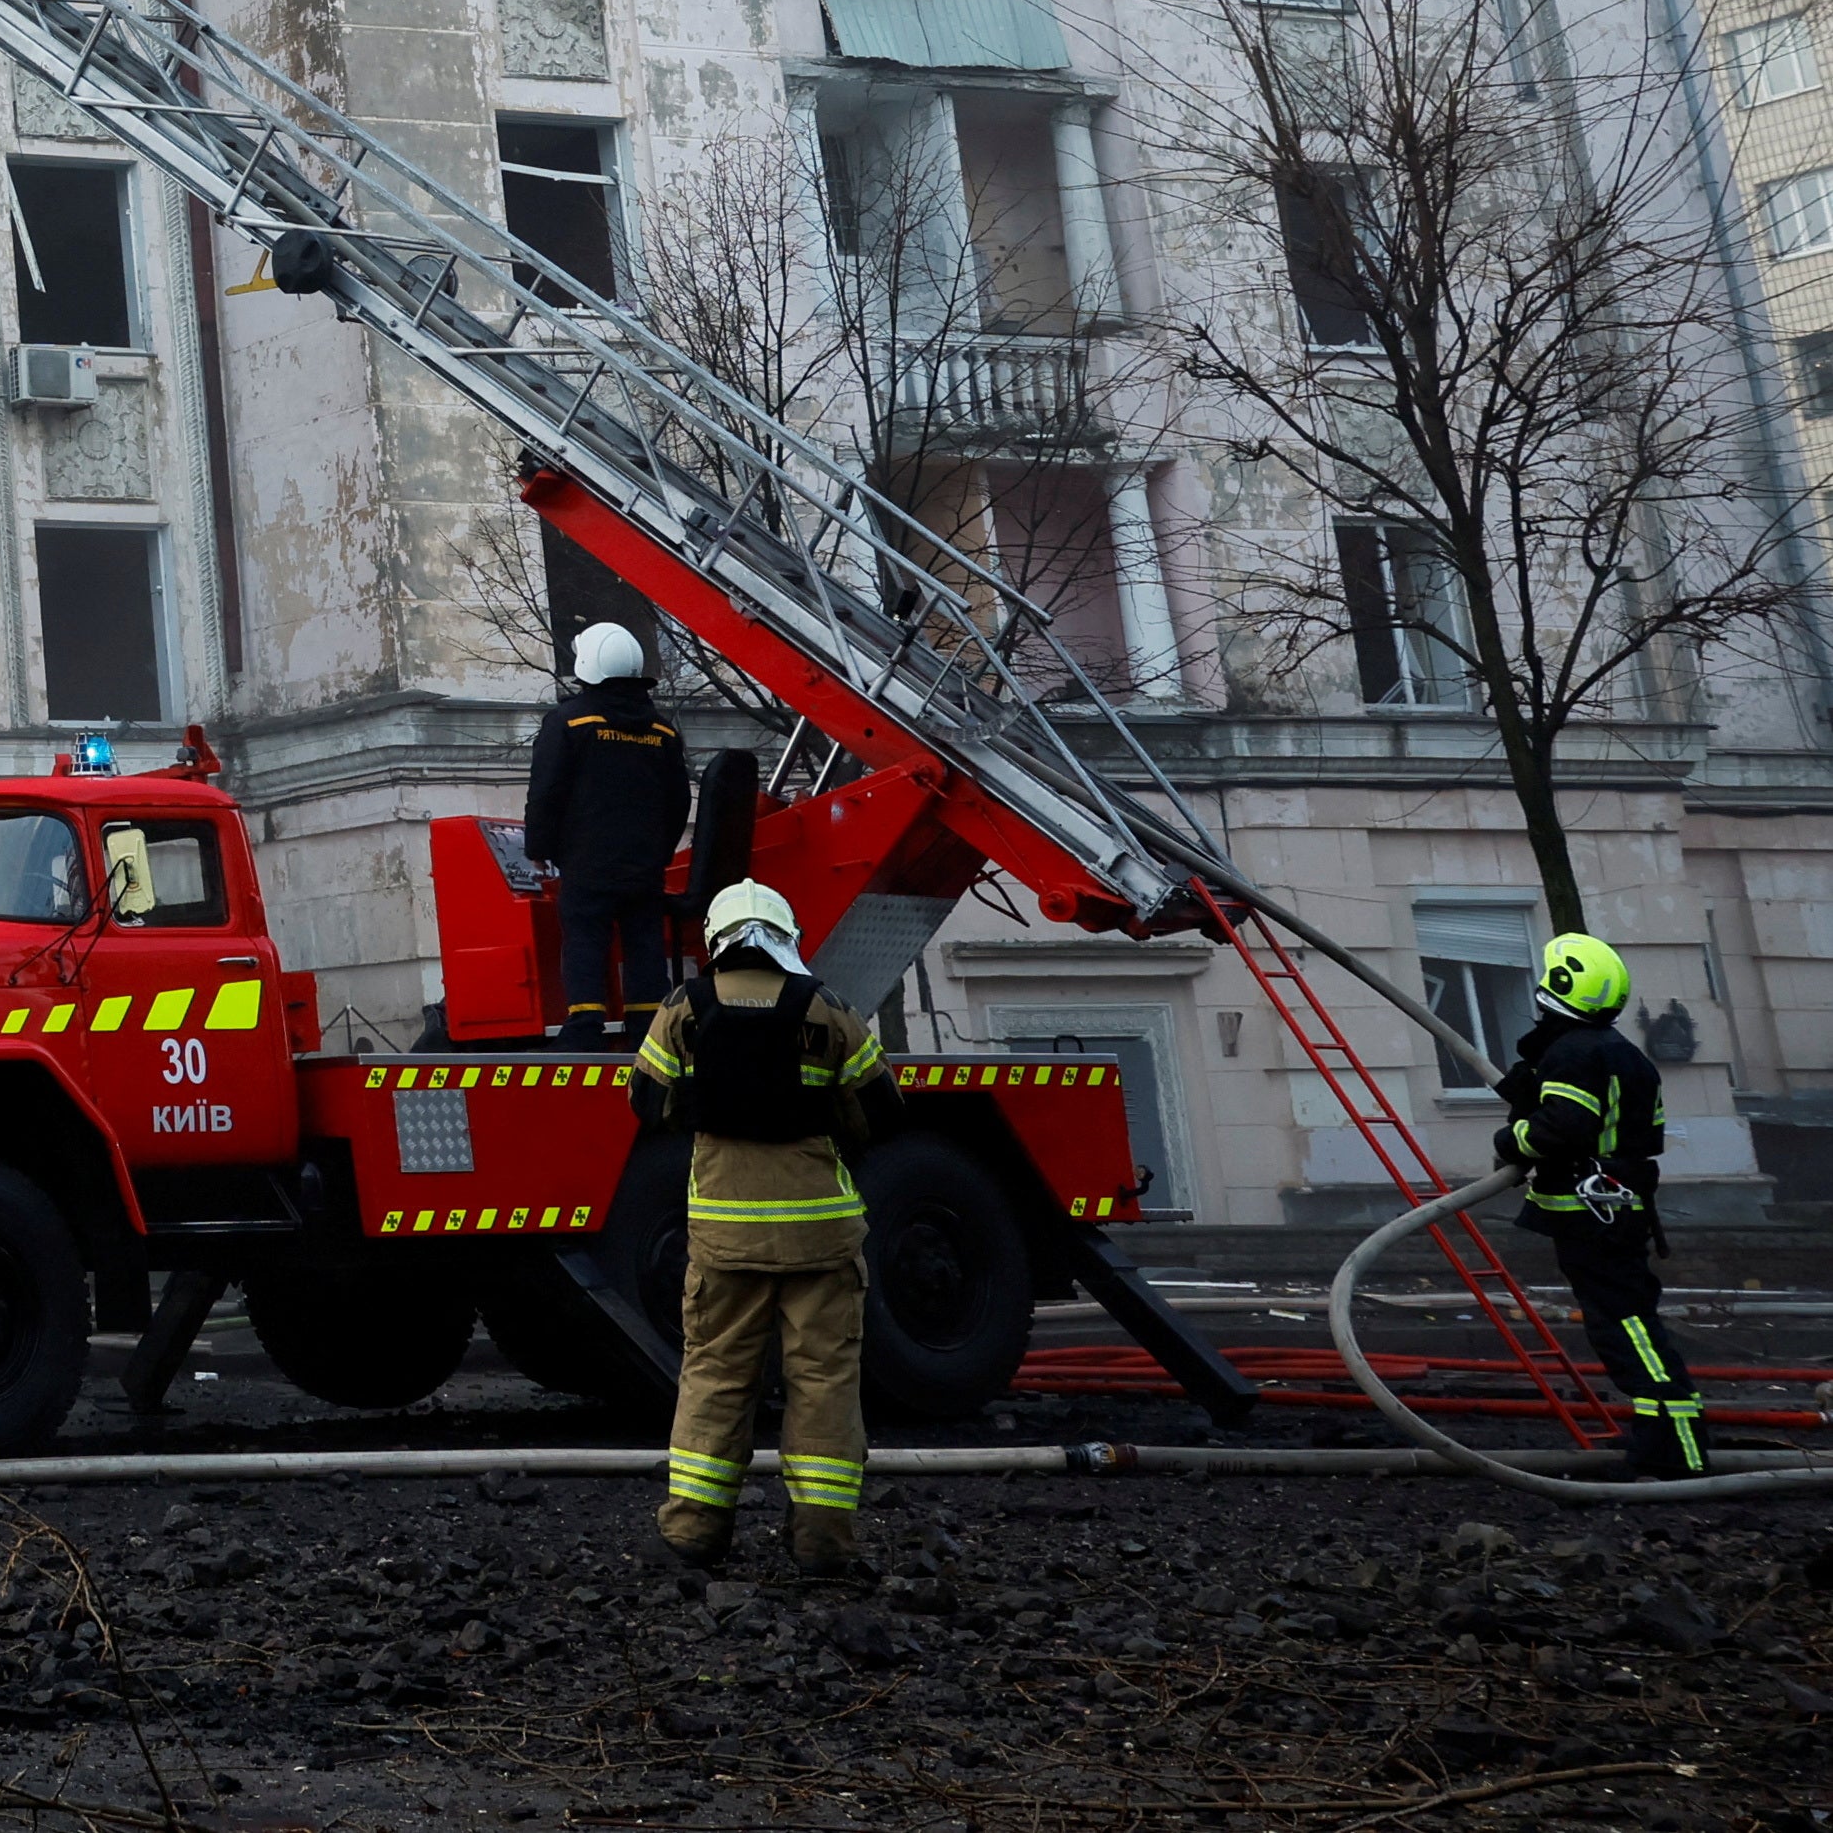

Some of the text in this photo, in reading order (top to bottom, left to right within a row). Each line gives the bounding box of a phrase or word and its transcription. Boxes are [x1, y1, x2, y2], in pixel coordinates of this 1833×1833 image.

[596, 728, 662, 747] РЯТУВАЛЬНИК
[160, 1038, 207, 1084] 30
[152, 1099, 233, 1133] КИЇВ
